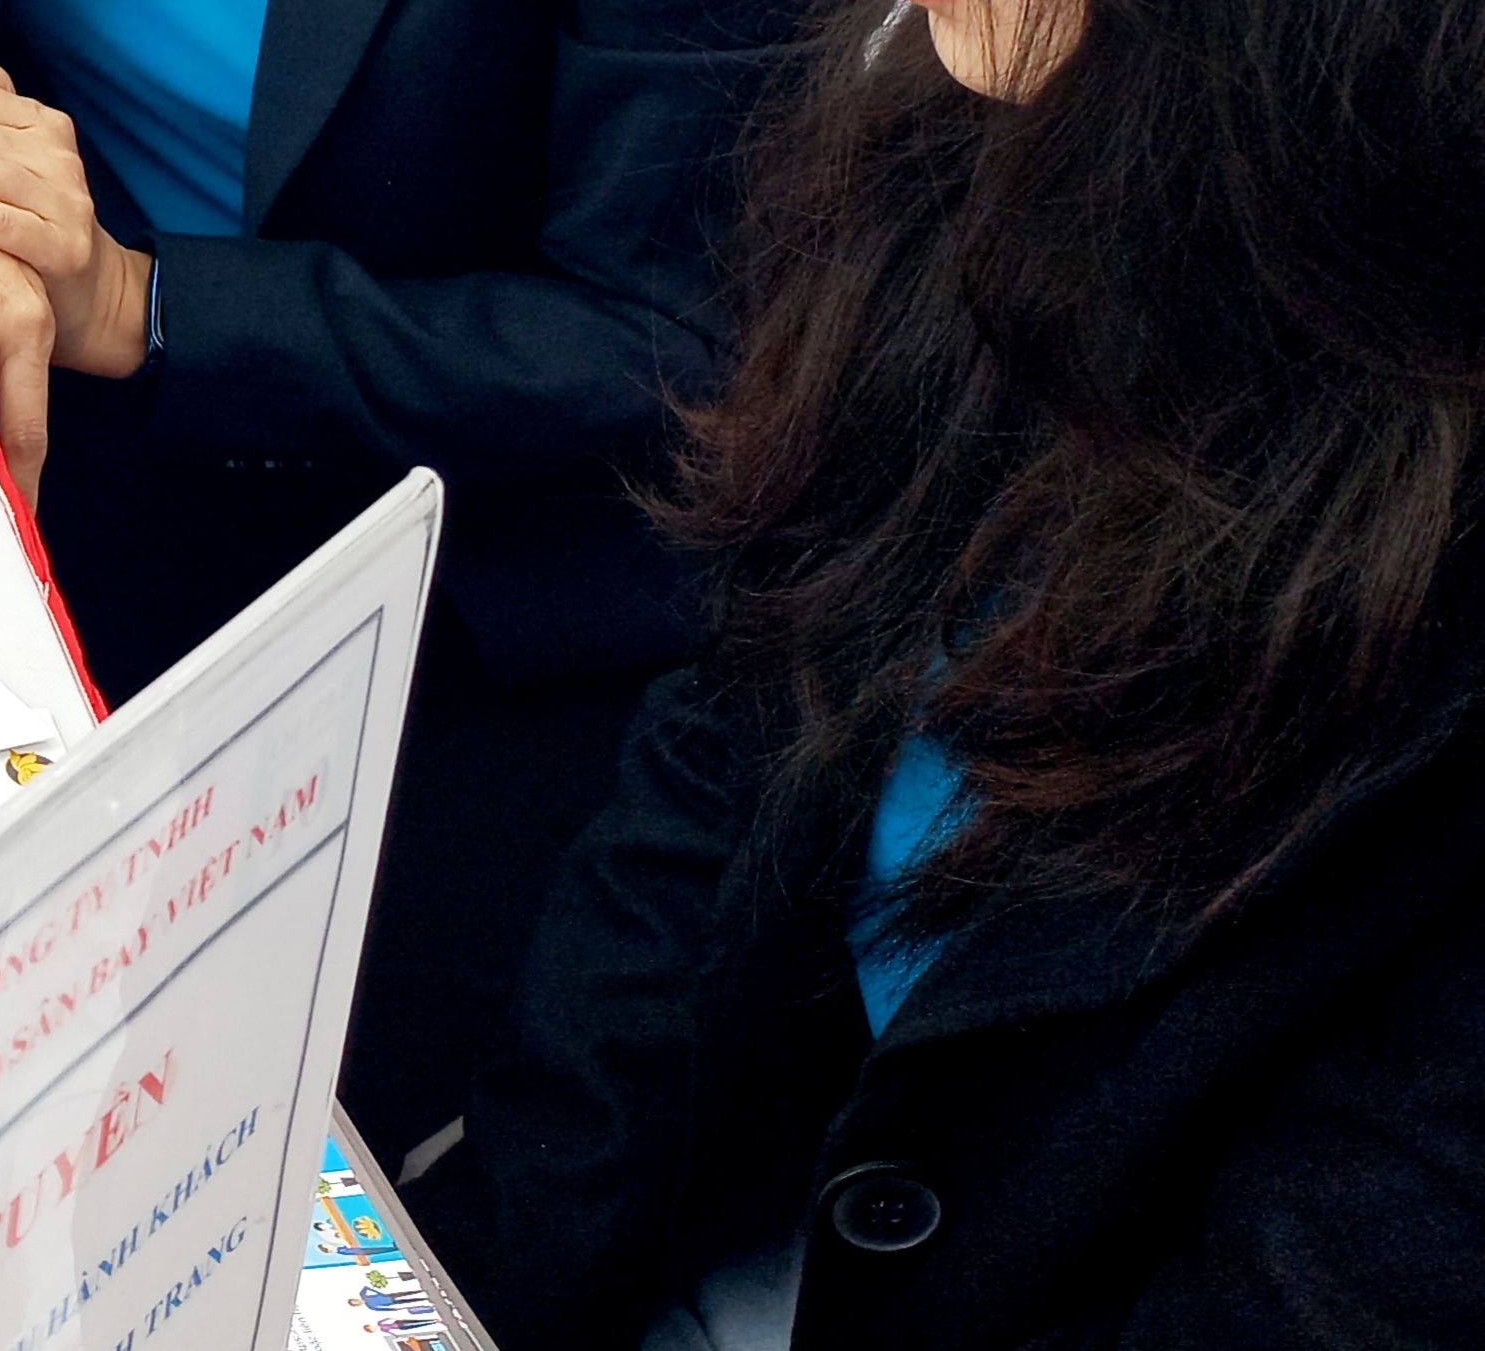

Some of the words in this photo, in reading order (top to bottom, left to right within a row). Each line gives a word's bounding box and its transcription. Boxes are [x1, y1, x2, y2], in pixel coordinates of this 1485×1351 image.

[66, 881, 110, 934] TY
[120, 785, 216, 888] TNHH
[87, 915, 160, 998] BAY
[164, 839, 241, 924] VIỆT
[245, 774, 320, 860] NAM
[47, 1225, 142, 1338] HÀNH
[148, 1105, 260, 1238] KHÁCH
[145, 1216, 248, 1337] TRANG
